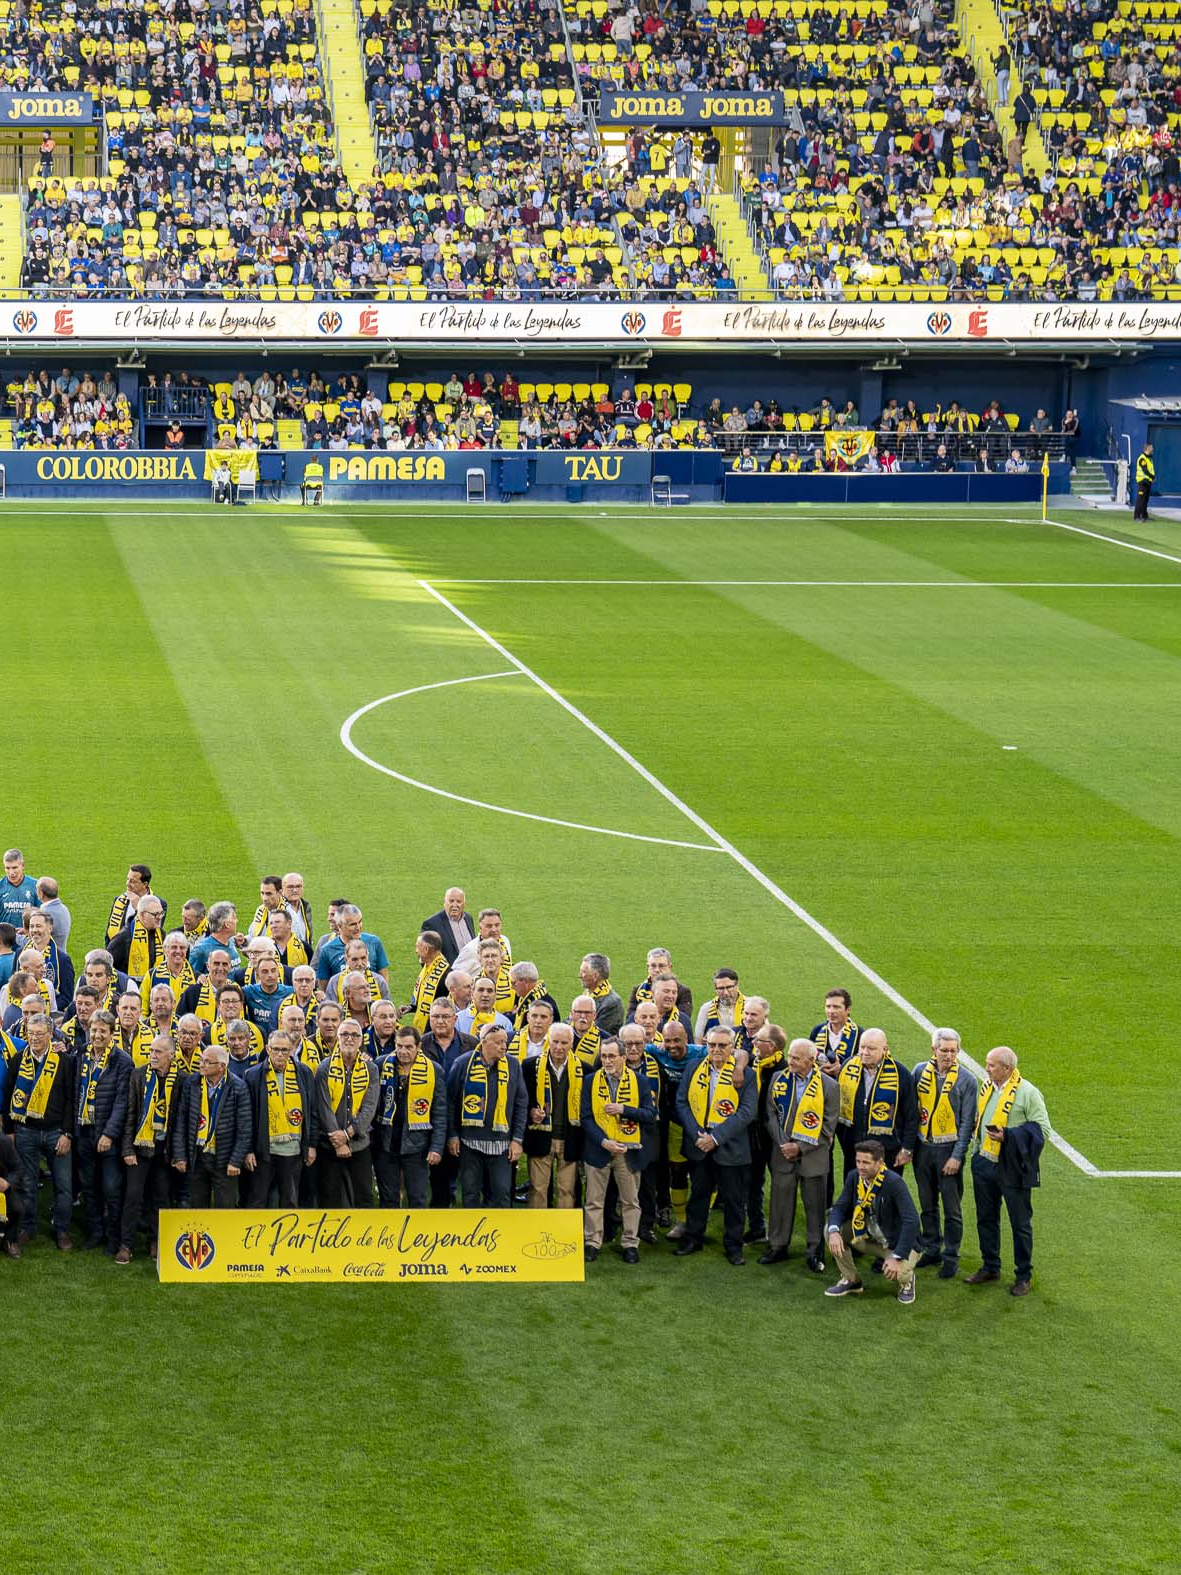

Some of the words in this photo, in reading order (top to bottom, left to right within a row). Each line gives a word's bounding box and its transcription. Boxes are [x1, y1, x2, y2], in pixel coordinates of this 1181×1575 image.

[115, 309, 131, 327] El
[219, 306, 276, 334] Leyendas
[419, 310, 435, 328] El
[523, 306, 581, 334] Leyendas
[724, 310, 740, 328] El
[828, 307, 885, 335] Leyendas
[1034, 311, 1050, 329] El
[37, 456, 197, 481] COLOROBBIA
[329, 456, 446, 481] PAMESA
[564, 456, 624, 481] TAU
[241, 1223, 266, 1250] El
[269, 1212, 352, 1256] Partido
[356, 1226, 373, 1247] de
[377, 1226, 396, 1249] las
[397, 1215, 501, 1262] Leyendas
[227, 1264, 265, 1272] PAMESA
[293, 1265, 333, 1275] CaixaBank
[475, 1265, 517, 1273] ZOOMEX
